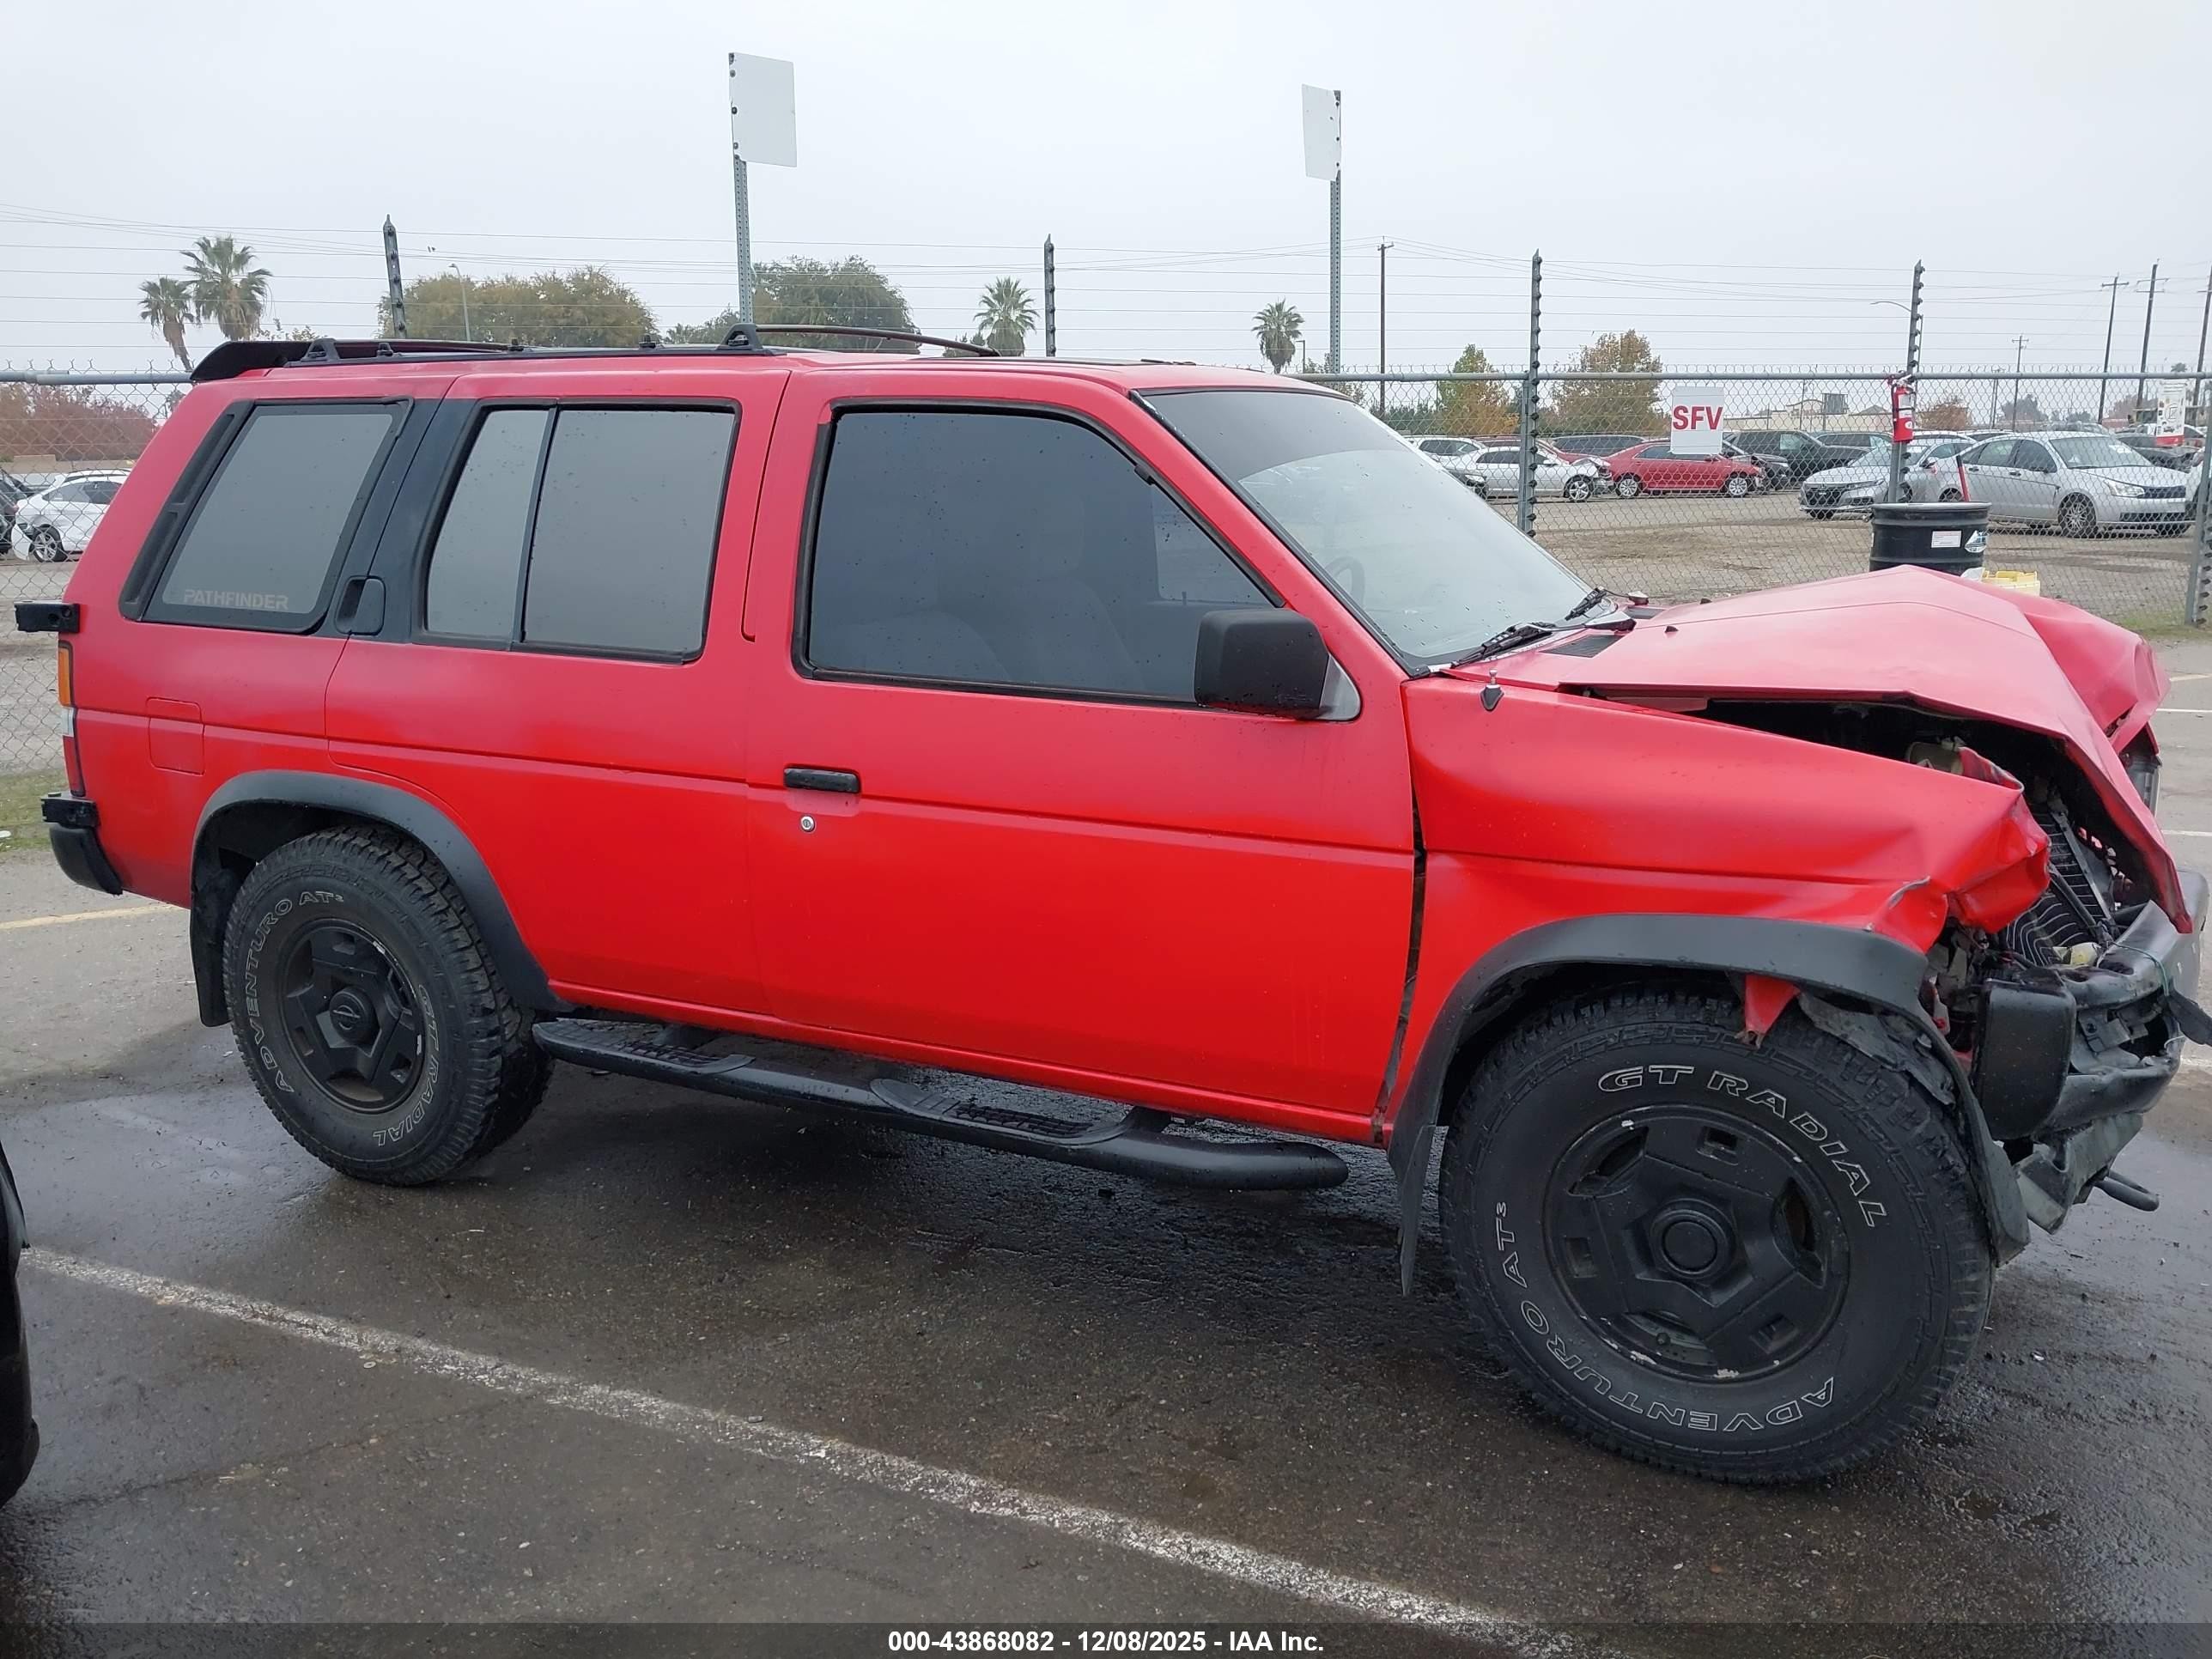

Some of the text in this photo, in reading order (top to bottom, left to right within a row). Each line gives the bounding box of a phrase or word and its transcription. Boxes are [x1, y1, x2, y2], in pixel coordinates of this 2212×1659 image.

[1672, 405, 1723, 430] SFV
[185, 589, 289, 610] PATHFINDER
[246, 899, 295, 1092] ADVENTURO
[373, 1054, 439, 1146] RADIAL
[1598, 1065, 1887, 1227] GT RADIAL
[1521, 1300, 1834, 1432] ADVENTURO
